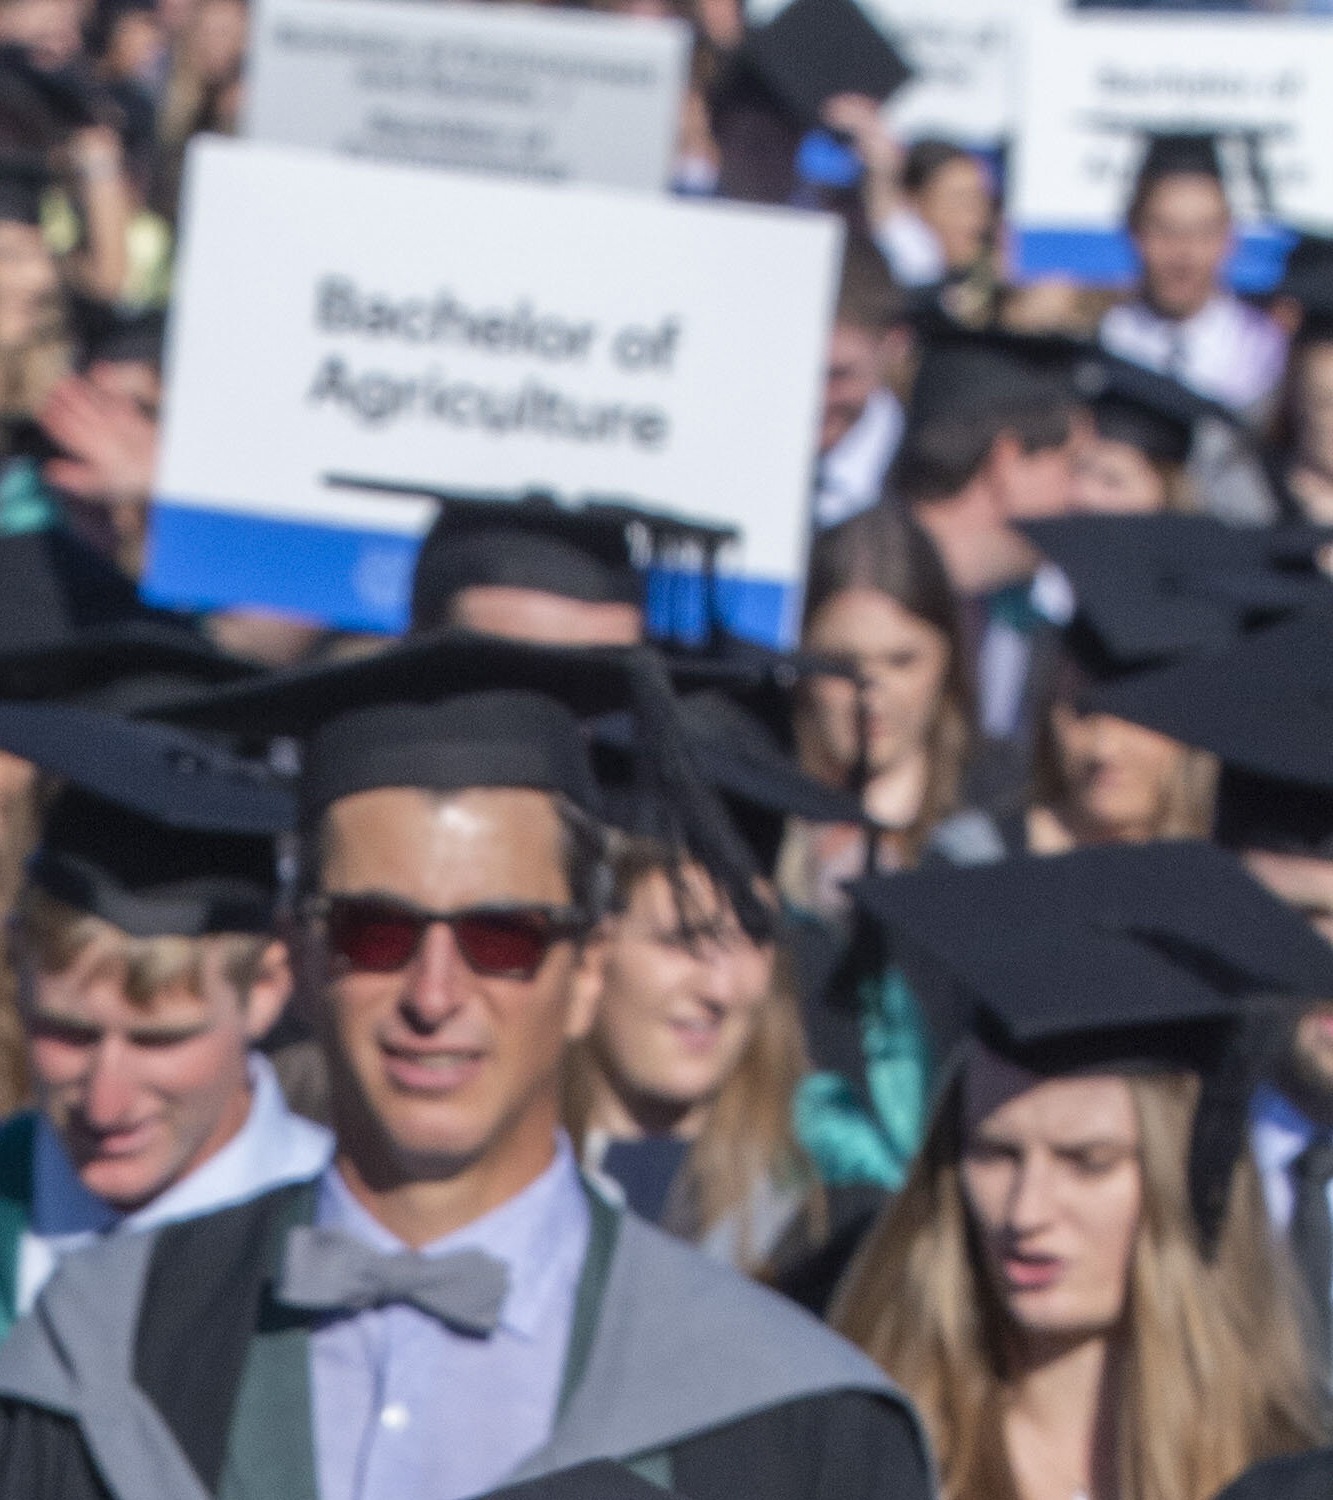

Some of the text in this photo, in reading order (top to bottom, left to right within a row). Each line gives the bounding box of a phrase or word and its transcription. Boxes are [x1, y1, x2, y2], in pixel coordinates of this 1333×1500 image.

[316, 273, 680, 370] Bachelor of
[309, 354, 670, 450] Agriculture
